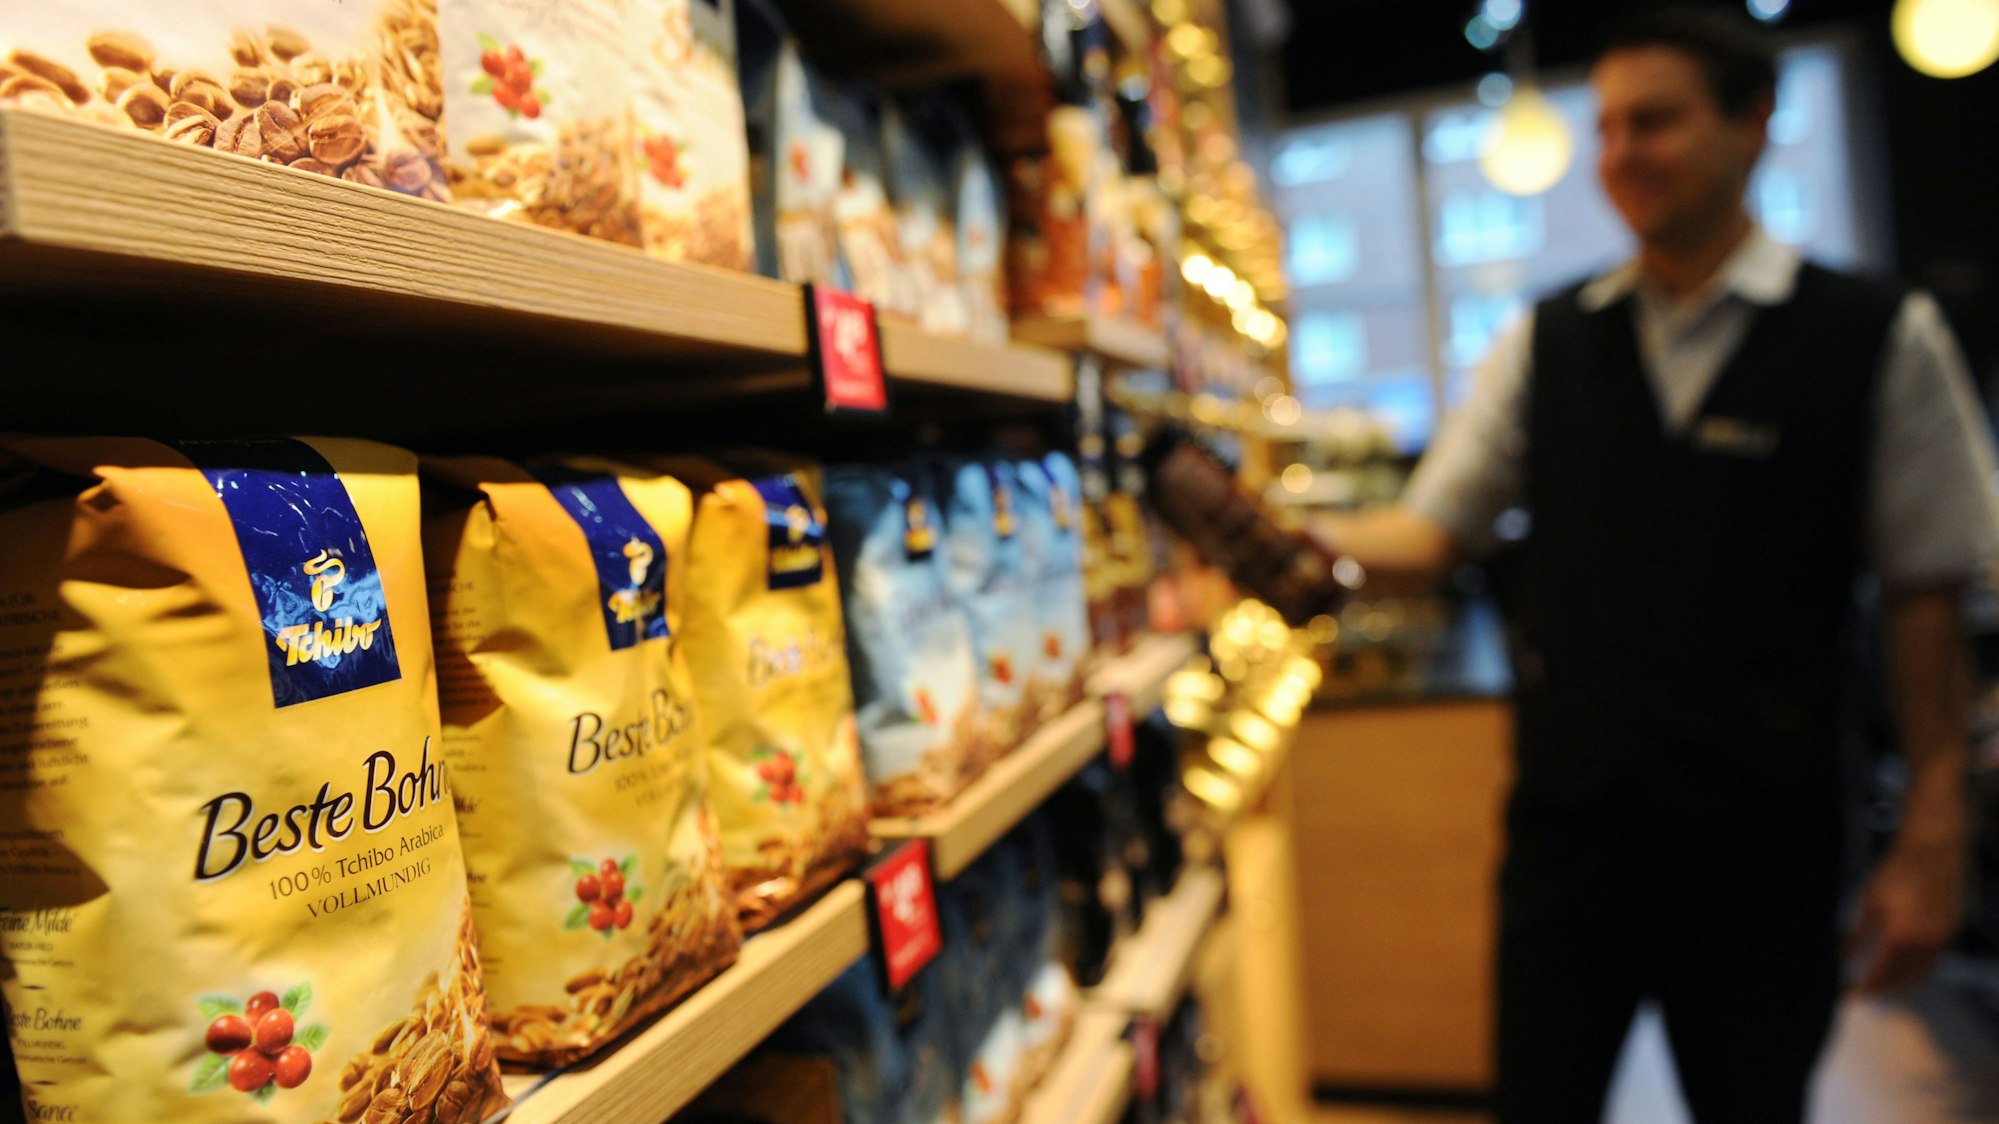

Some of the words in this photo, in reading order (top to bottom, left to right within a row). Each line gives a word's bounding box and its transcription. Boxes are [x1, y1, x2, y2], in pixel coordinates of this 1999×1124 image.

[276, 617, 381, 667] Tchibo
[194, 782, 355, 883] Beste
[336, 846, 395, 879] Tchibo
[399, 823, 445, 857] Arabica
[306, 856, 431, 918] VOLLMUNDIG
[34, 1007, 81, 1031] Bohne
